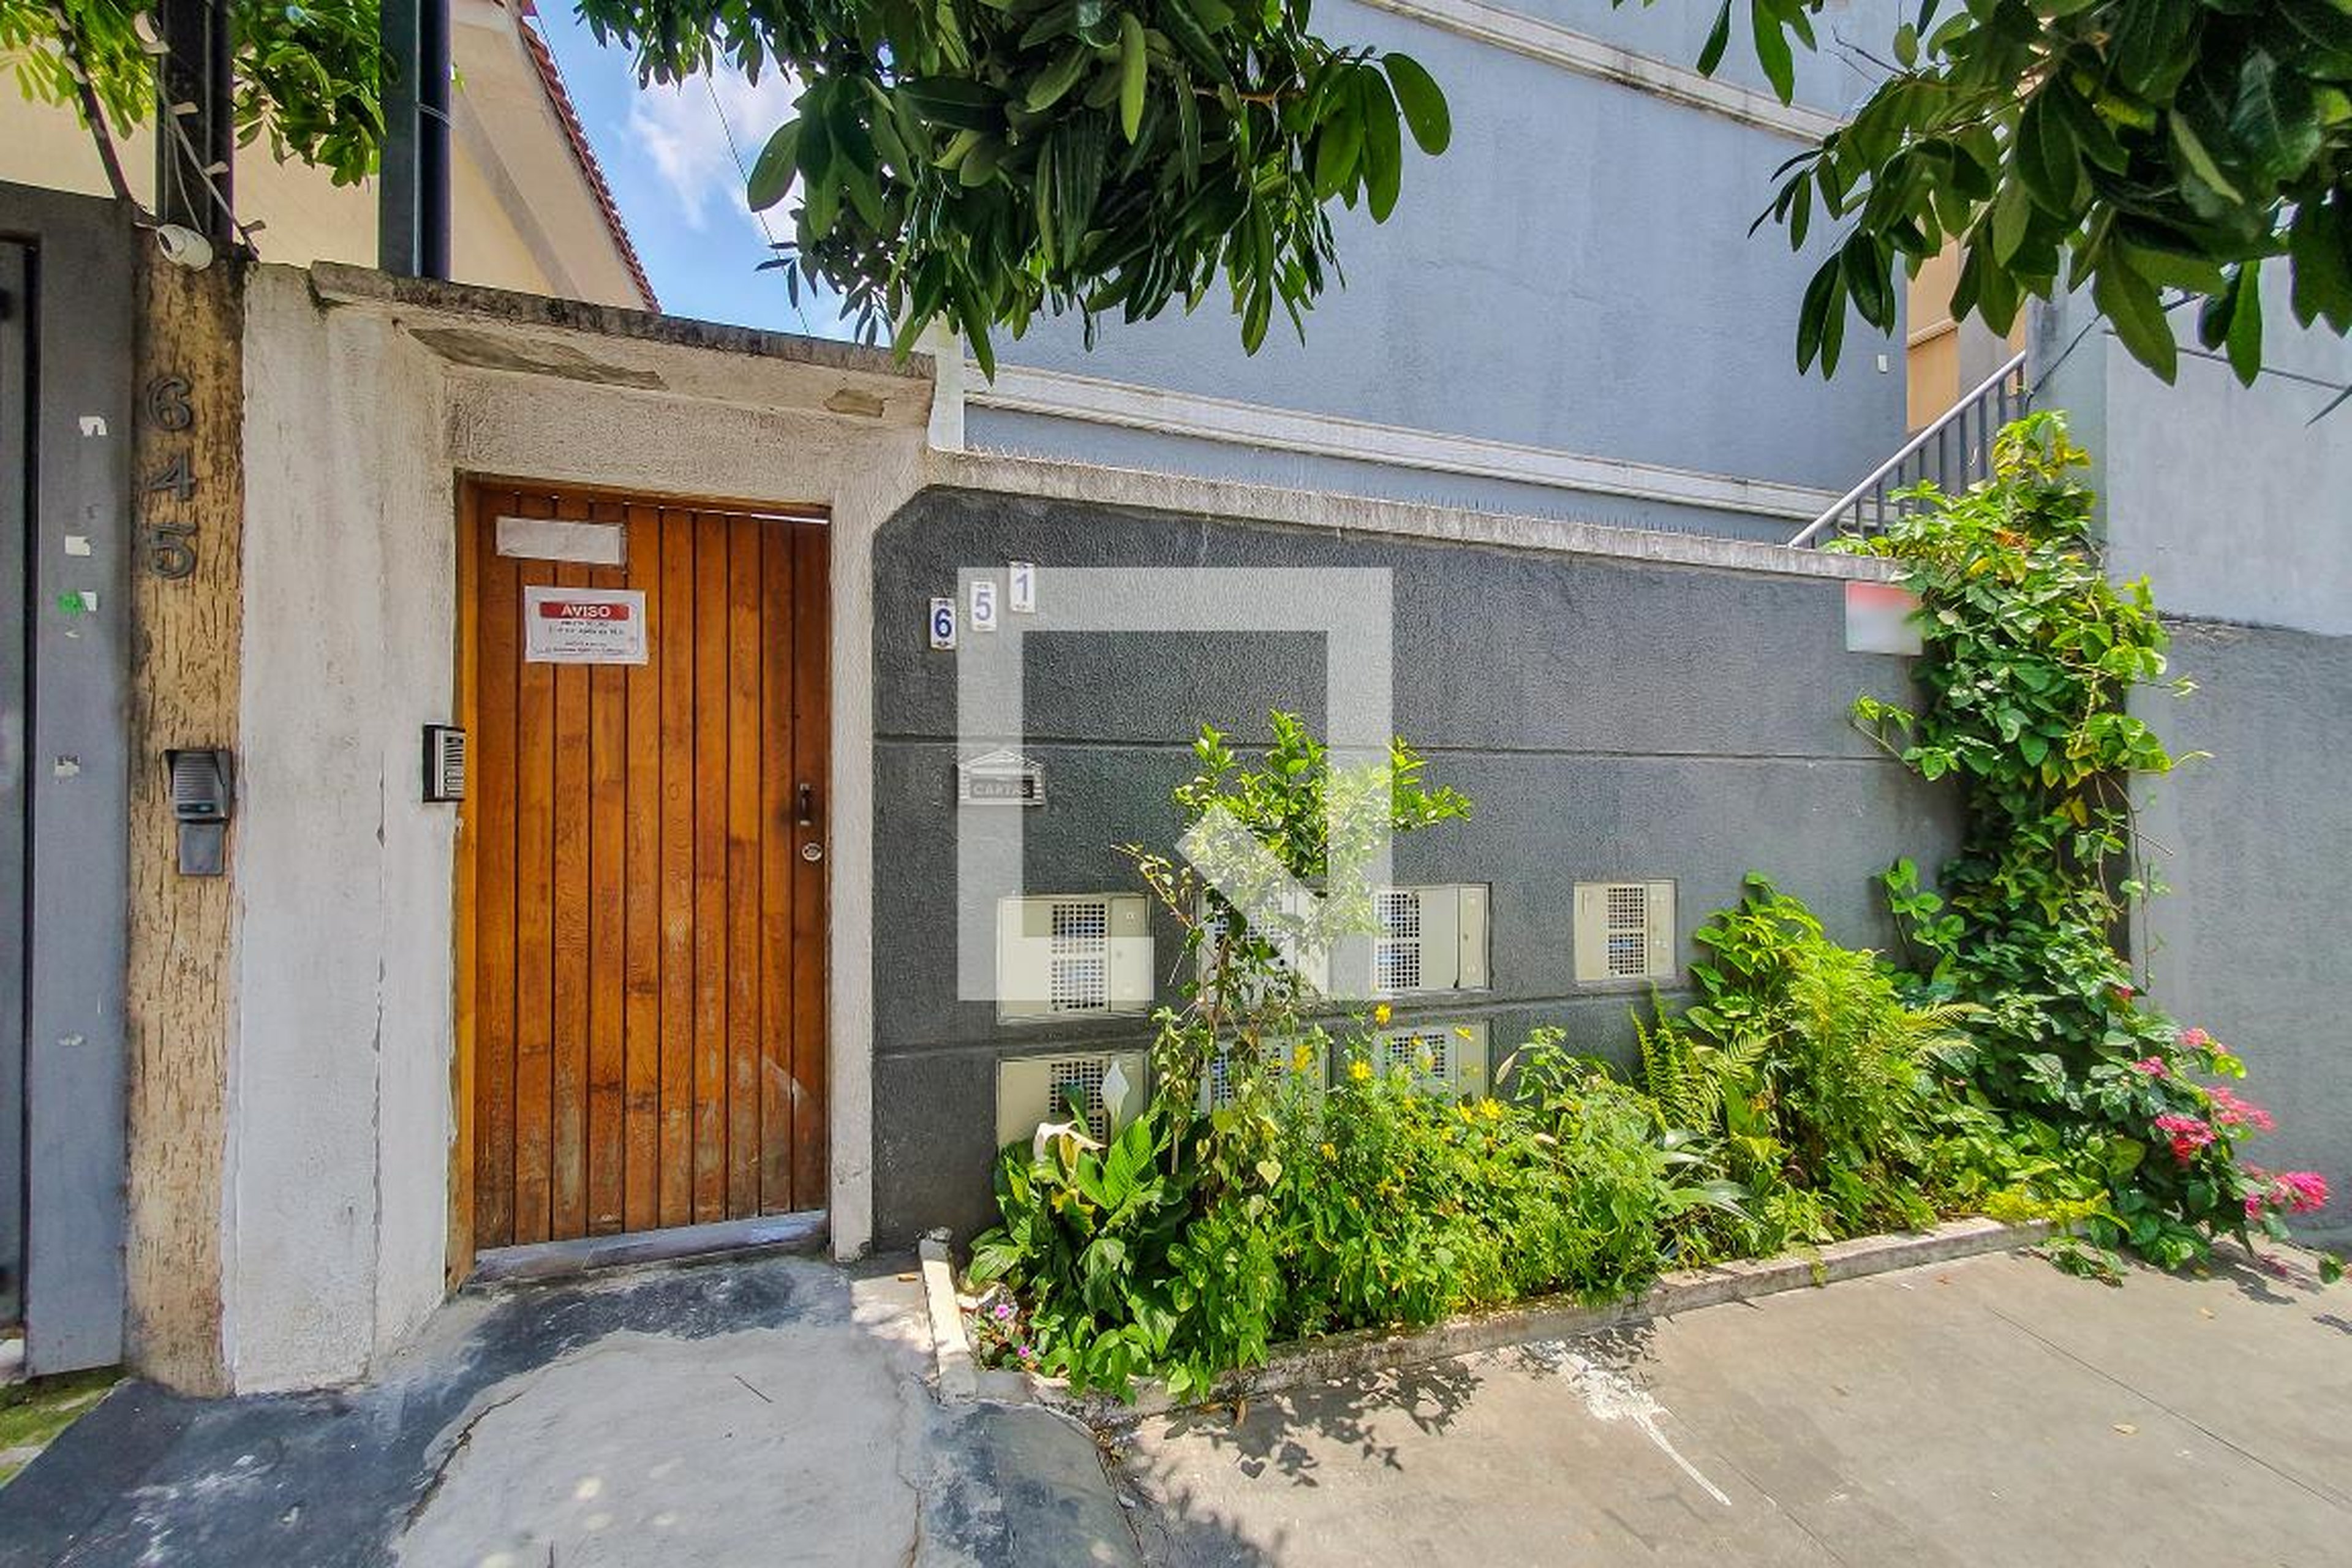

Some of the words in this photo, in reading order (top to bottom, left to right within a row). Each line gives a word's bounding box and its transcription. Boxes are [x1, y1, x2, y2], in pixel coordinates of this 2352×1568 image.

[146, 376, 198, 581] 645
[560, 604, 611, 618] AVISO
[934, 573, 1029, 639] 651
[973, 783, 1030, 796] CARTAS
